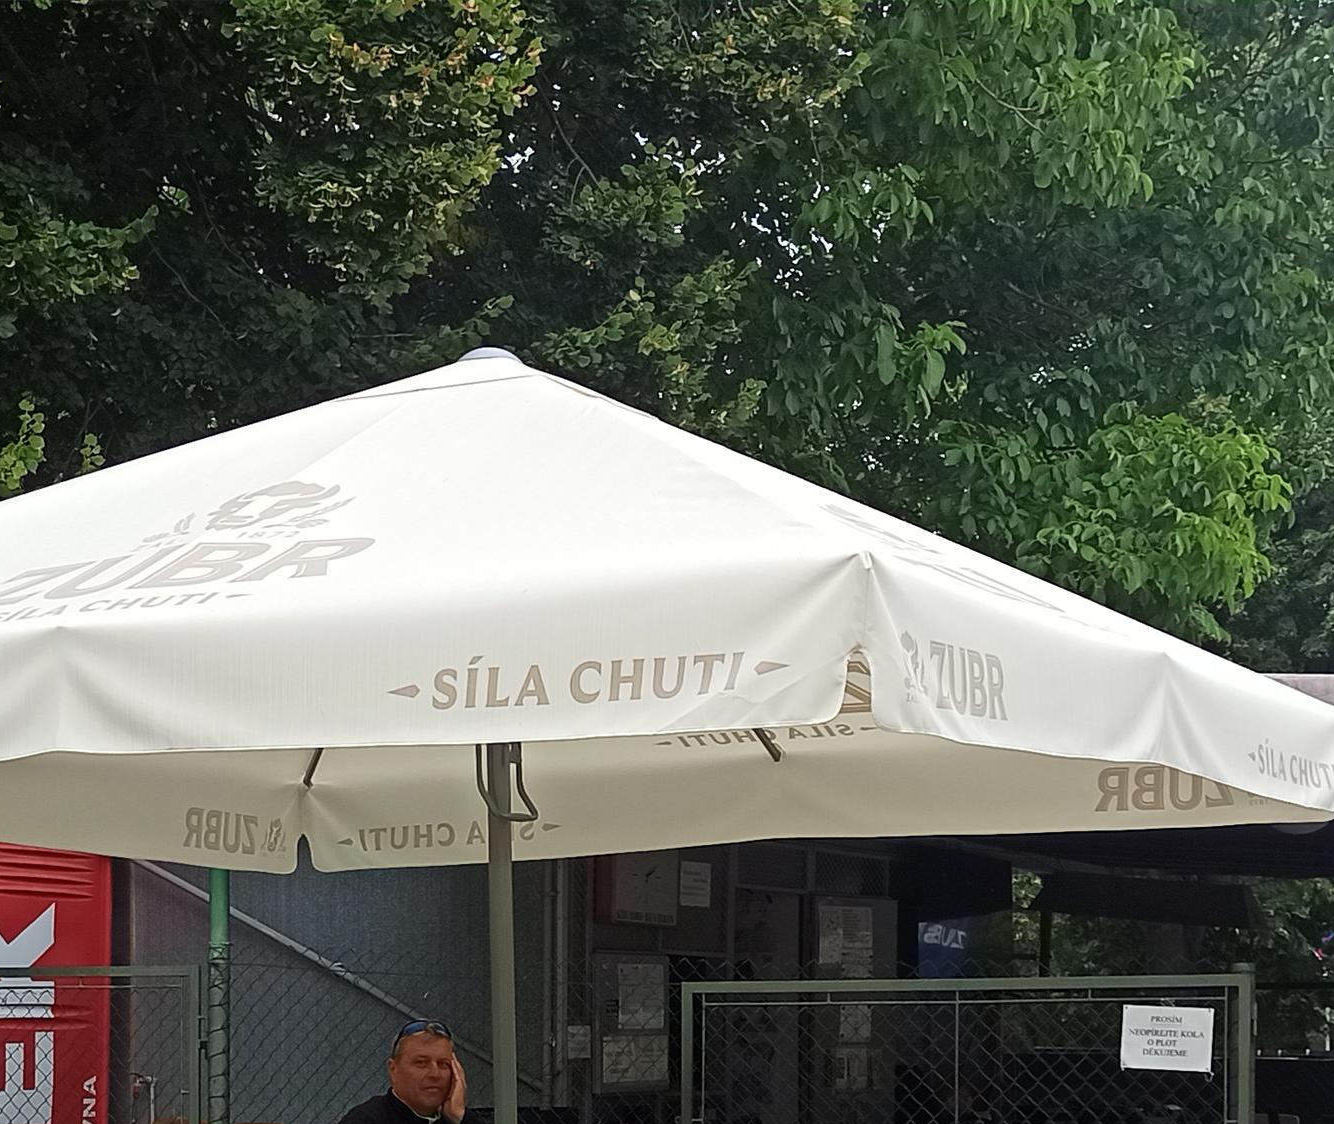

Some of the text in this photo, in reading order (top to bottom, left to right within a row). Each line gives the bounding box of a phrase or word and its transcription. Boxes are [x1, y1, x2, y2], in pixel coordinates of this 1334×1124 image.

[79, 592, 220, 612] CHUTI
[432, 652, 745, 710] SÍLA CHUTI
[930, 640, 1008, 721] ZUBR
[1258, 738, 1287, 781] SÍLA
[1150, 1015, 1183, 1023] PROSÍM
[1180, 1031, 1205, 1039] KOLA
[1155, 1039, 1178, 1047] PLOT
[1142, 1047, 1188, 1057] DĚKUJEME
